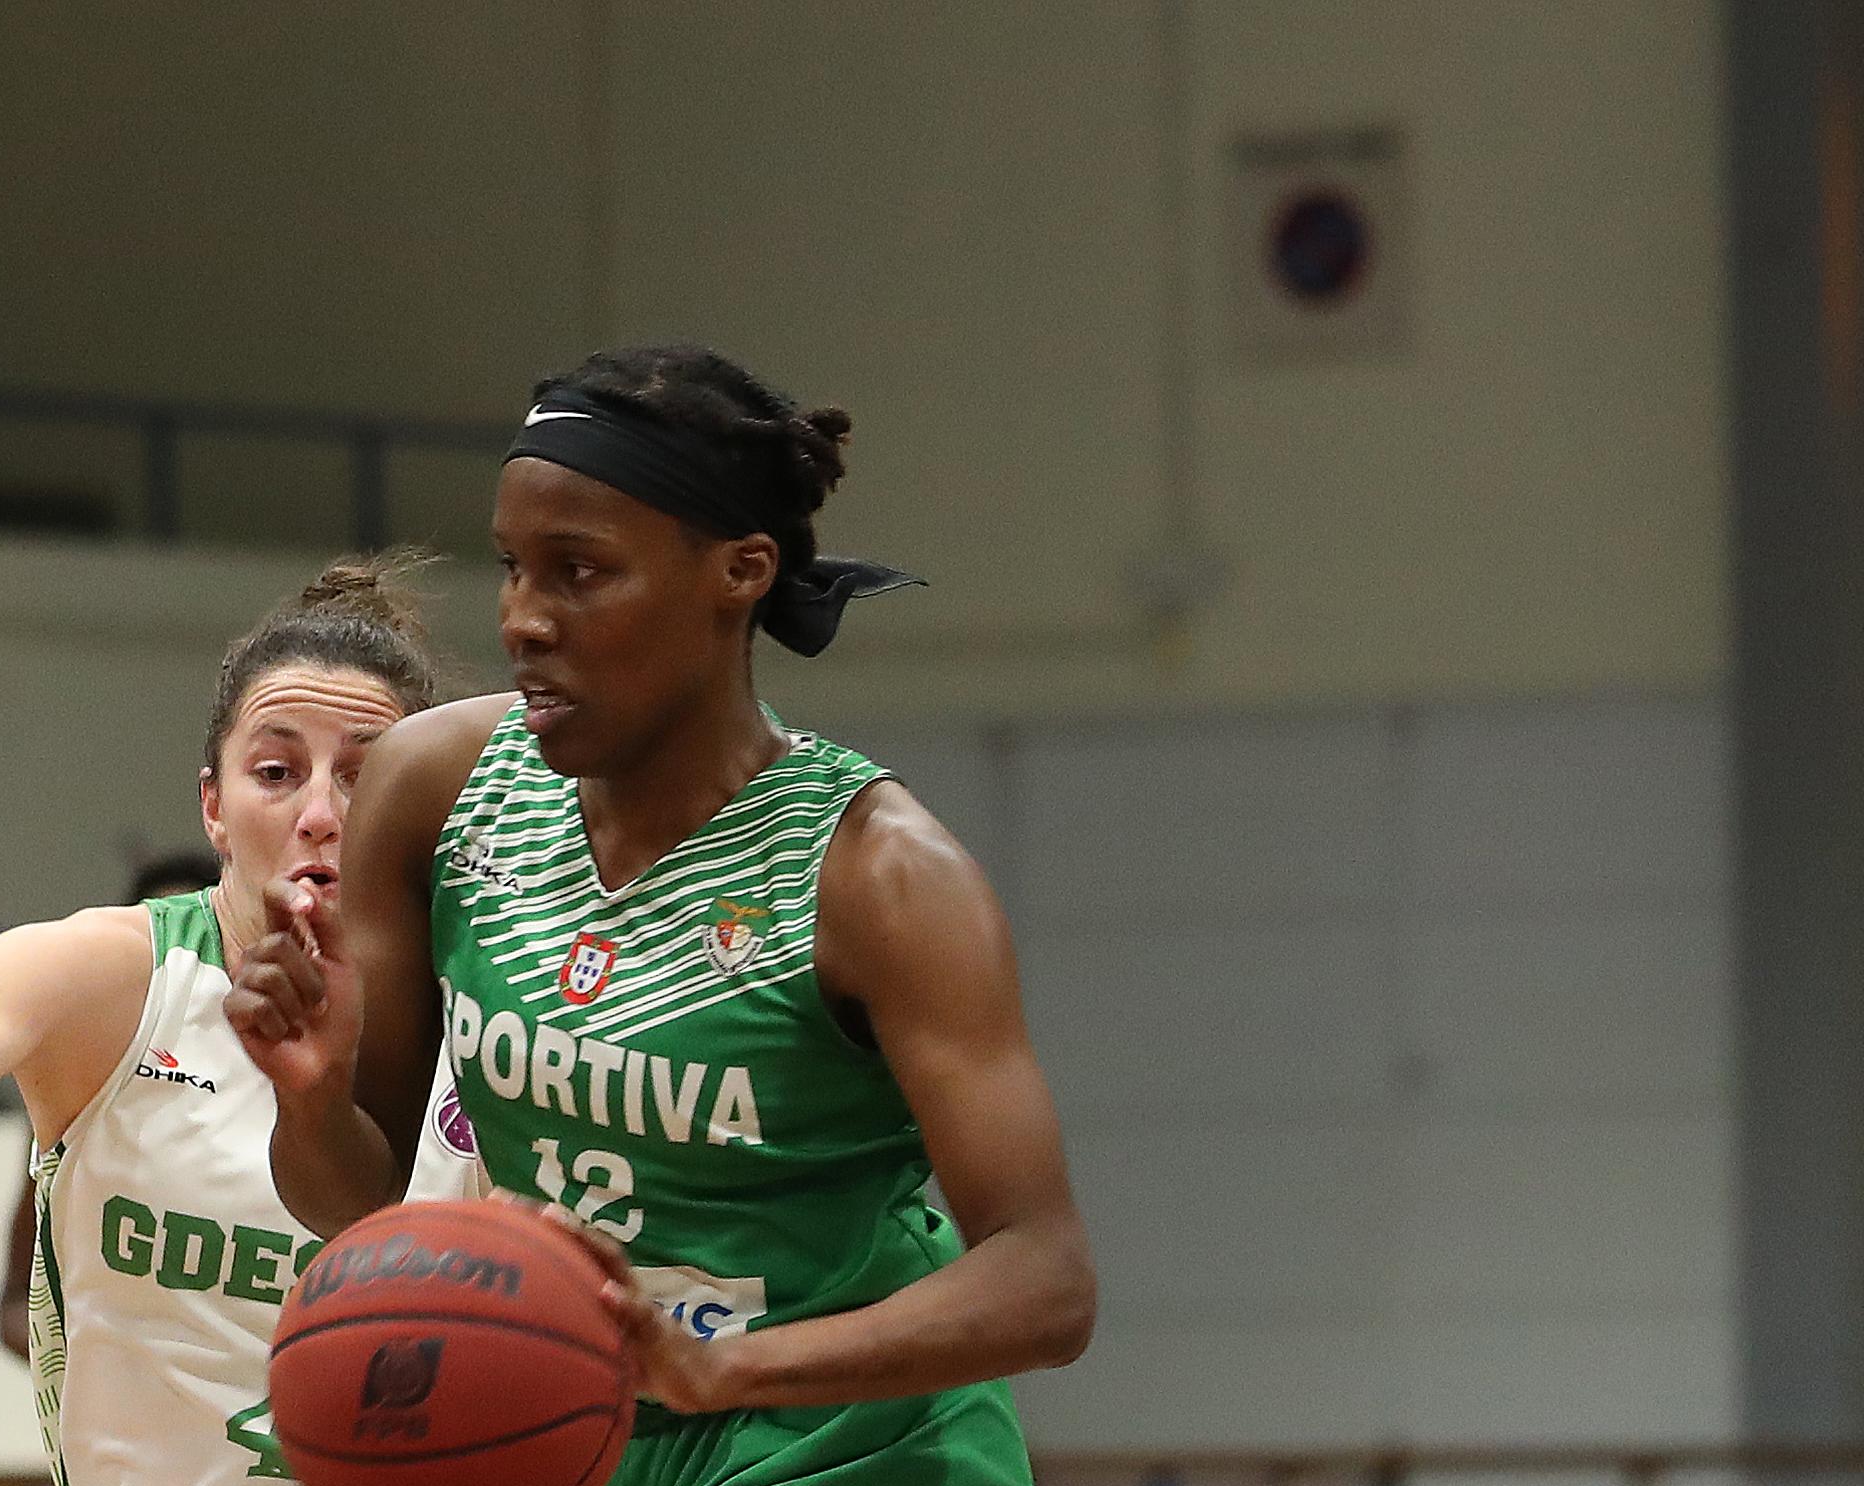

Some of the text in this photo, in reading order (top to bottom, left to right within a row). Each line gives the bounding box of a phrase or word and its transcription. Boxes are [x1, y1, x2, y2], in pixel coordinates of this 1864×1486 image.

[531, 1138, 645, 1243] 12
[100, 1194, 328, 1306] GDE
[297, 1232, 524, 1308] Wilson
